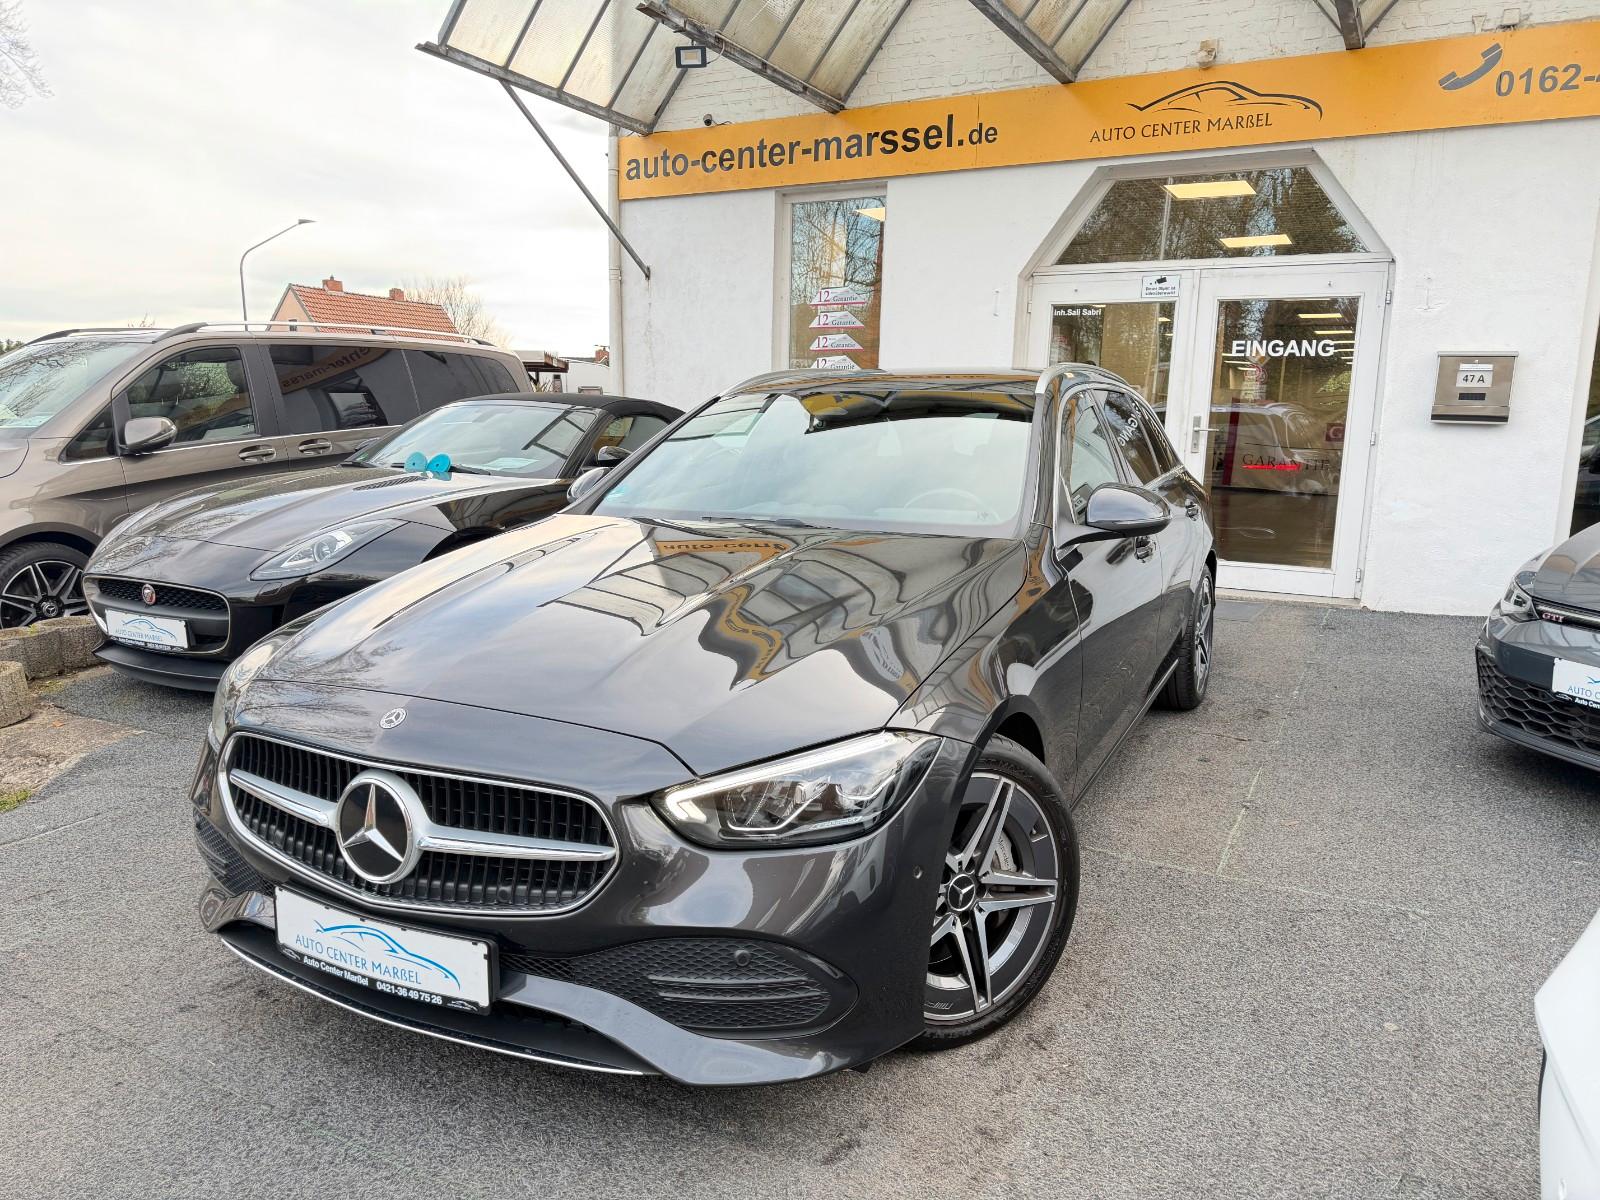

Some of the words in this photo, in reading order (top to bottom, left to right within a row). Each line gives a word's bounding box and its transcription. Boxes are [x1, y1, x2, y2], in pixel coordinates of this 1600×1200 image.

[1495, 63, 1600, 97] 0162-
[1089, 125, 1136, 143] AUTO
[1140, 118, 1202, 138] CENTER
[625, 113, 998, 181] auto-center-marssel.de
[818, 290, 830, 303] 12
[817, 313, 829, 326] 12
[815, 336, 828, 349] 12
[1231, 339, 1335, 357] EINGANG
[1462, 374, 1475, 383] 47
[1477, 374, 1486, 384] A
[1242, 453, 1331, 471] GARANTIE
[1542, 612, 1564, 623] GTI
[1568, 686, 1592, 697] AUTO
[1574, 697, 1588, 705] Auto
[295, 934, 324, 954] AUTO
[326, 946, 368, 970] CENTER
[303, 955, 320, 969] Auto
[320, 962, 344, 978] Center
[376, 981, 408, 997] 0421-36
[408, 990, 419, 1000] 49
[420, 992, 431, 1002] 75
[431, 994, 443, 1005] 26
